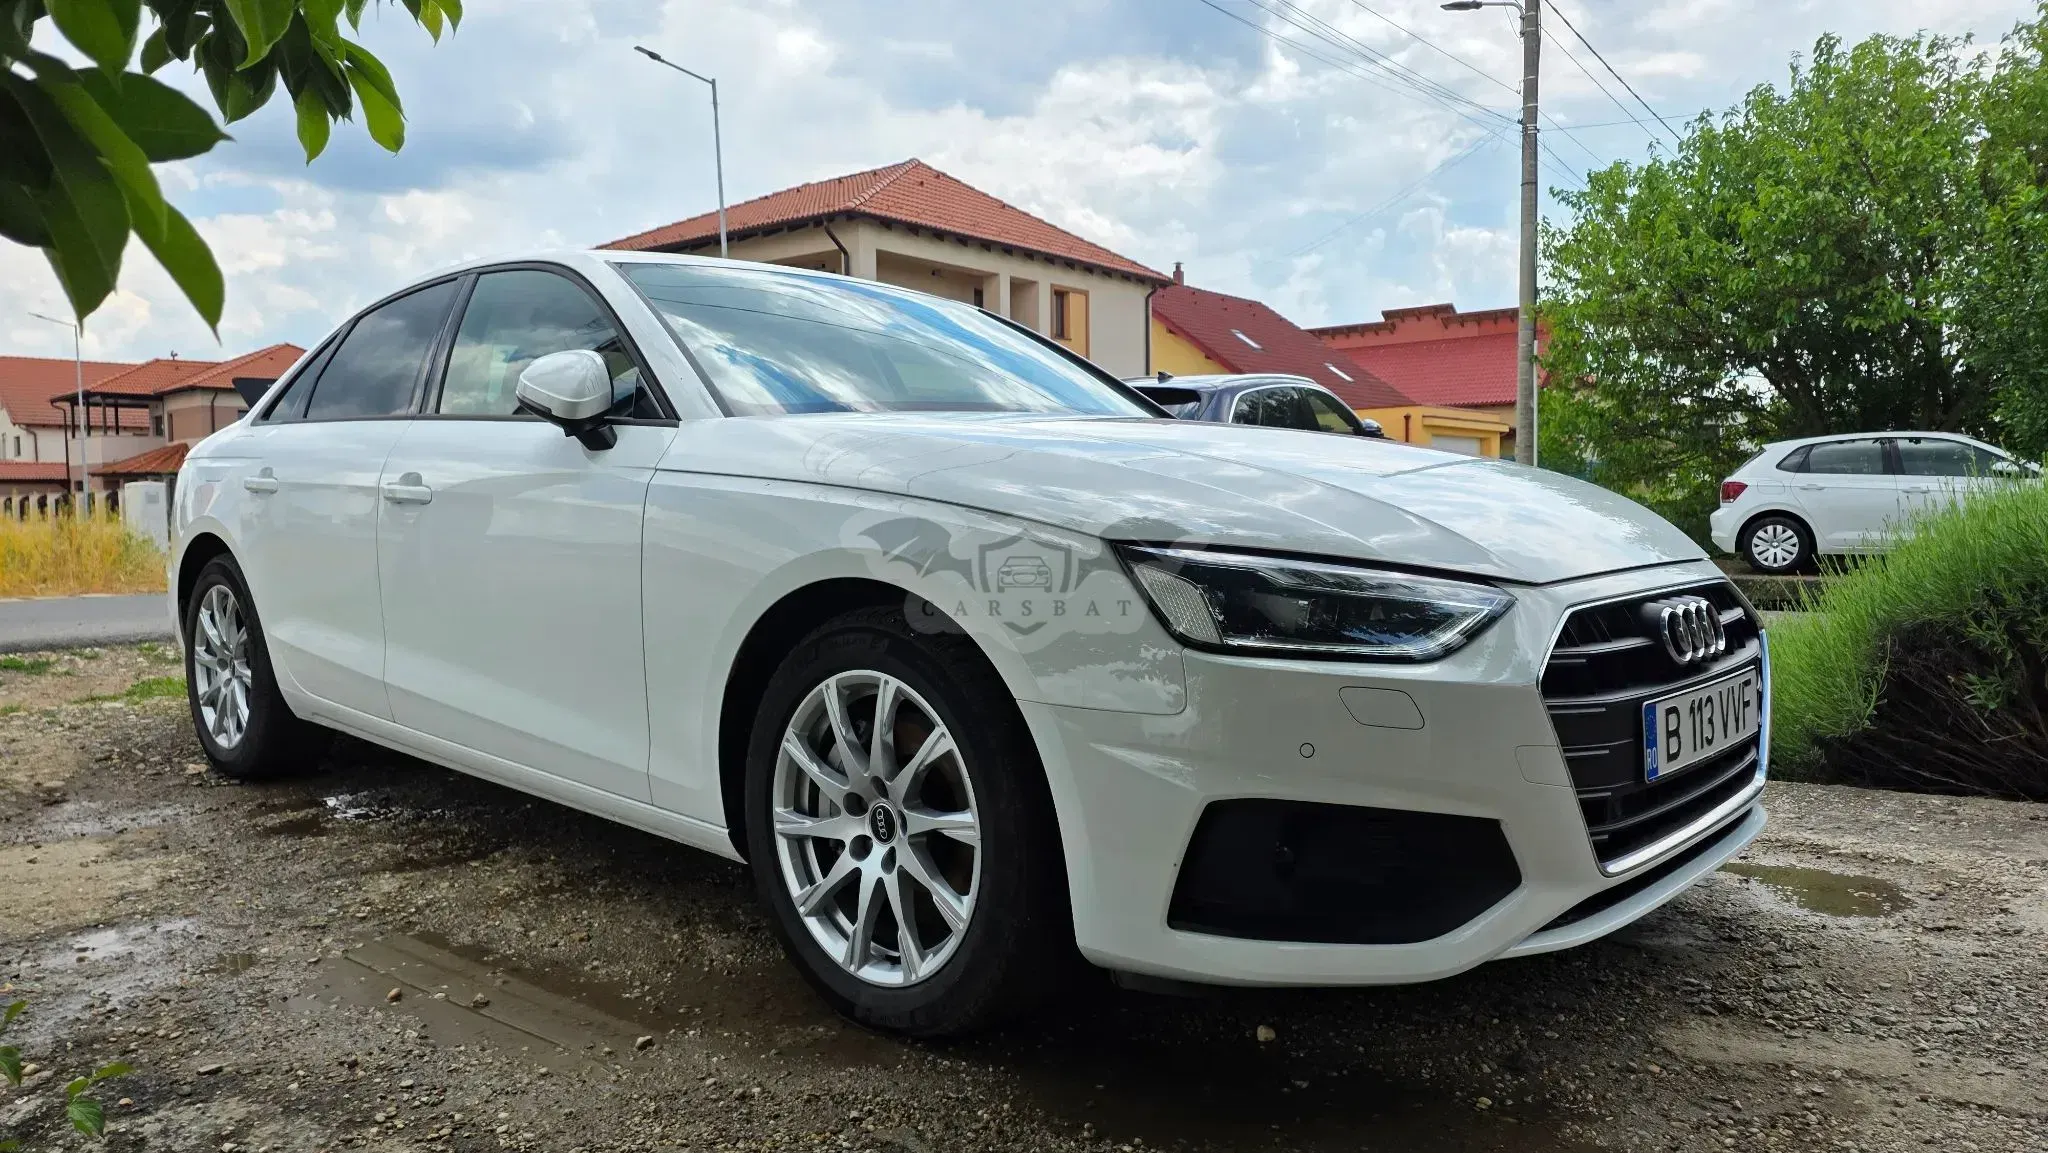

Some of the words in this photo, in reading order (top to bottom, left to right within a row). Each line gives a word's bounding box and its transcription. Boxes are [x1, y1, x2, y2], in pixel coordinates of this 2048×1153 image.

[1665, 705, 1682, 763] B
[1689, 695, 1715, 752] 113
[1719, 678, 1752, 739] VVF
[1646, 747, 1658, 771] RO
